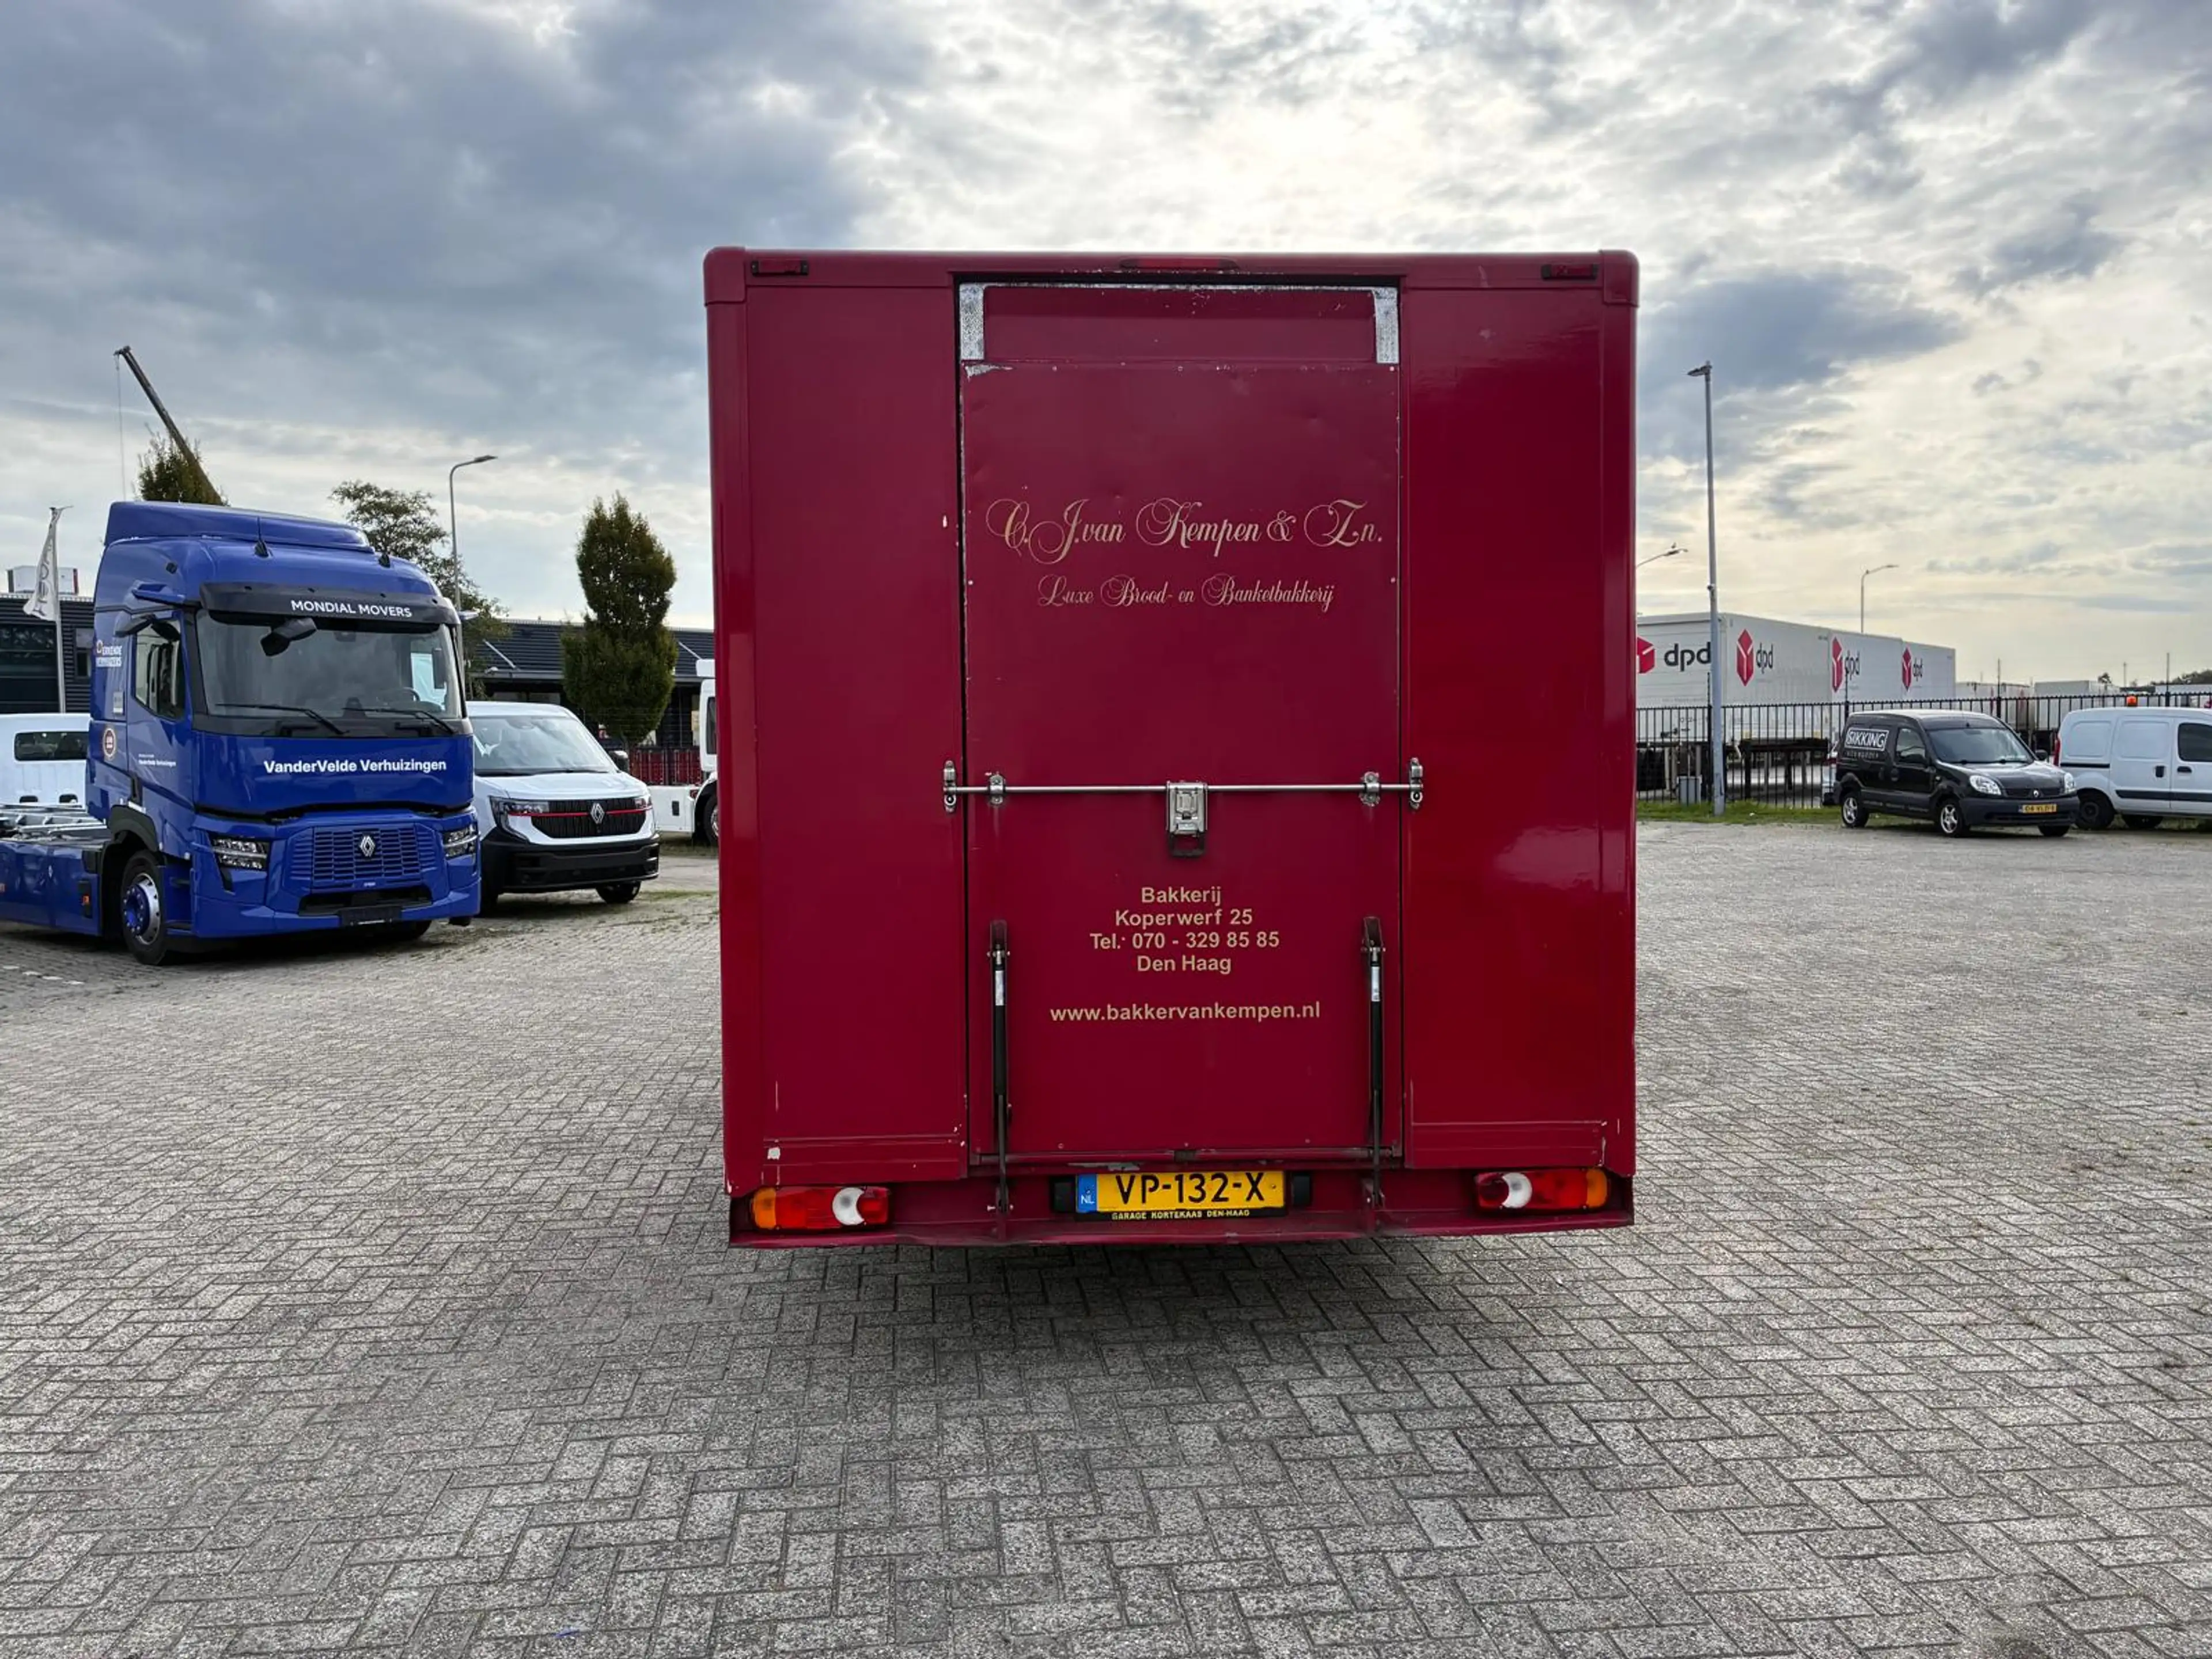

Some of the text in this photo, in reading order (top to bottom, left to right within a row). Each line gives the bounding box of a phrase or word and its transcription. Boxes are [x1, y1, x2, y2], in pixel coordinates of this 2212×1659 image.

[1136, 498, 1262, 557] Kempen
[1267, 510, 1296, 541] &
[1037, 573, 1335, 612] Luxe Brood- en Banketbakkerij
[290, 600, 412, 618] MONDIAL MOVERS
[1664, 641, 1711, 672] dpd
[1756, 642, 1773, 673] dpd
[264, 759, 446, 773] VanderVelde Verhuizingen
[1141, 887, 1221, 906] Bakkerij
[1115, 908, 1253, 930] Koperwerf 25
[1132, 933, 1165, 949] 070
[1185, 931, 1220, 948] 329
[1226, 931, 1249, 948] 85
[1256, 931, 1280, 948] 85
[1137, 955, 1232, 975] Den Haag
[1050, 1001, 1321, 1022] www.bakkervankempen.nl
[1115, 1172, 1265, 1205] VP-132-X
[1081, 1194, 1095, 1205] NL
[1112, 1212, 1147, 1220] GARAGE
[1152, 1210, 1202, 1219] KORTEKAAS
